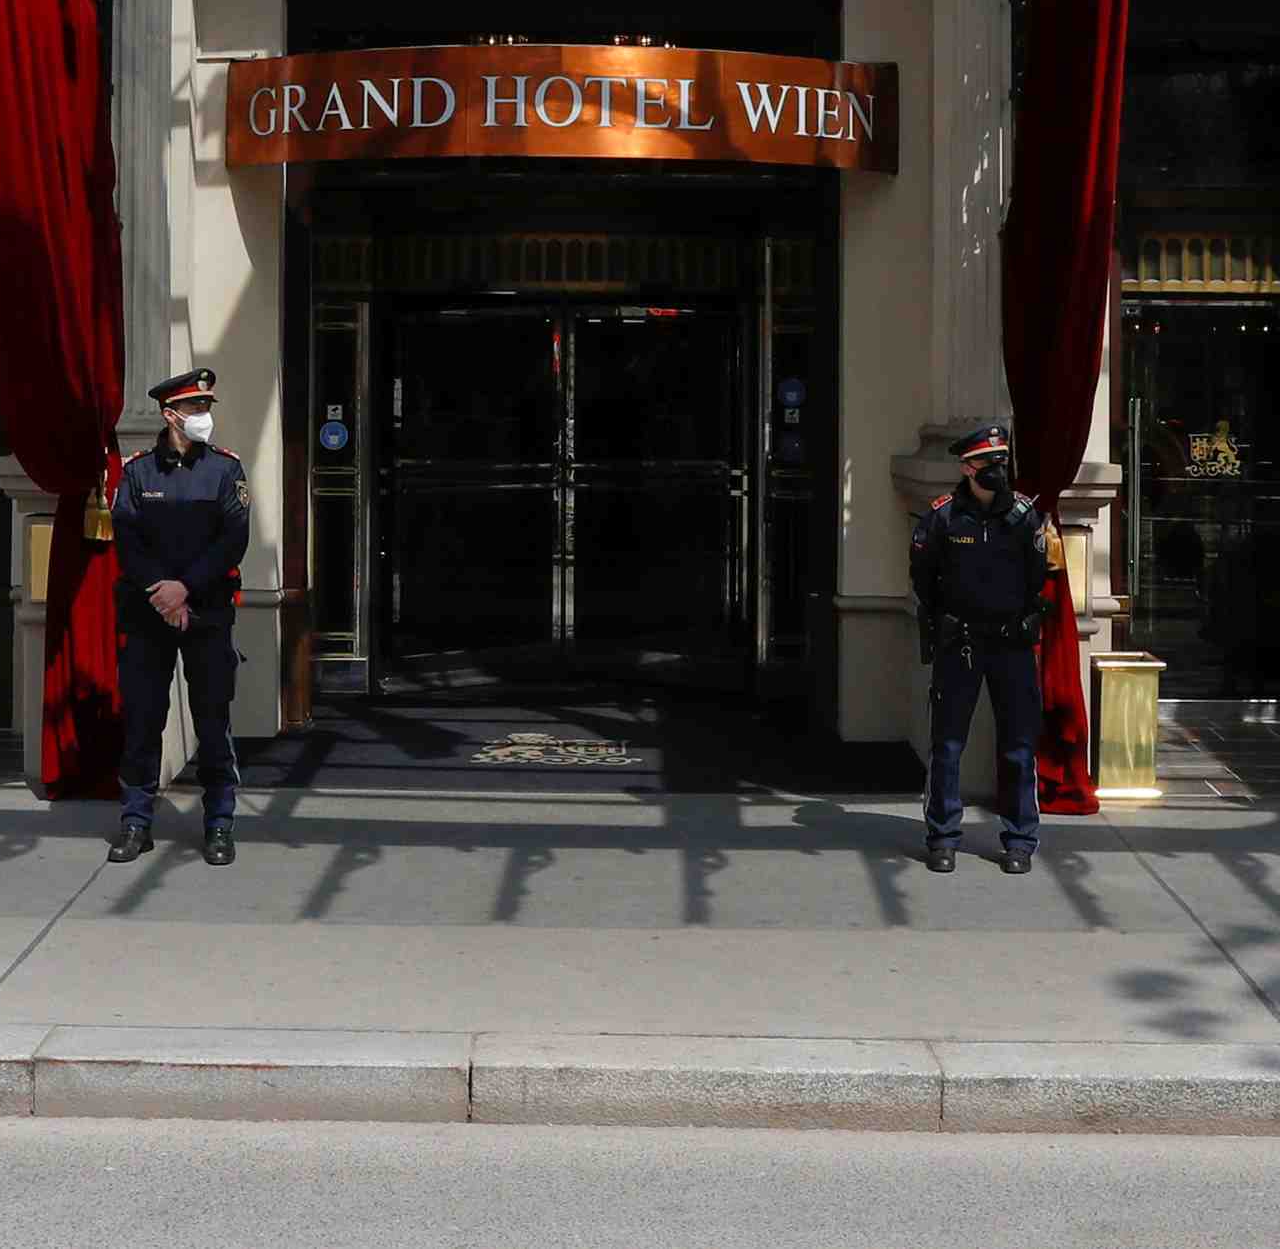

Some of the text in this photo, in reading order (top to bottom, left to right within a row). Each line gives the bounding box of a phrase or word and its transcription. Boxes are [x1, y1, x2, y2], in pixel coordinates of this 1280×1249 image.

[249, 74, 874, 143] GRAND HOTEL WIEN
